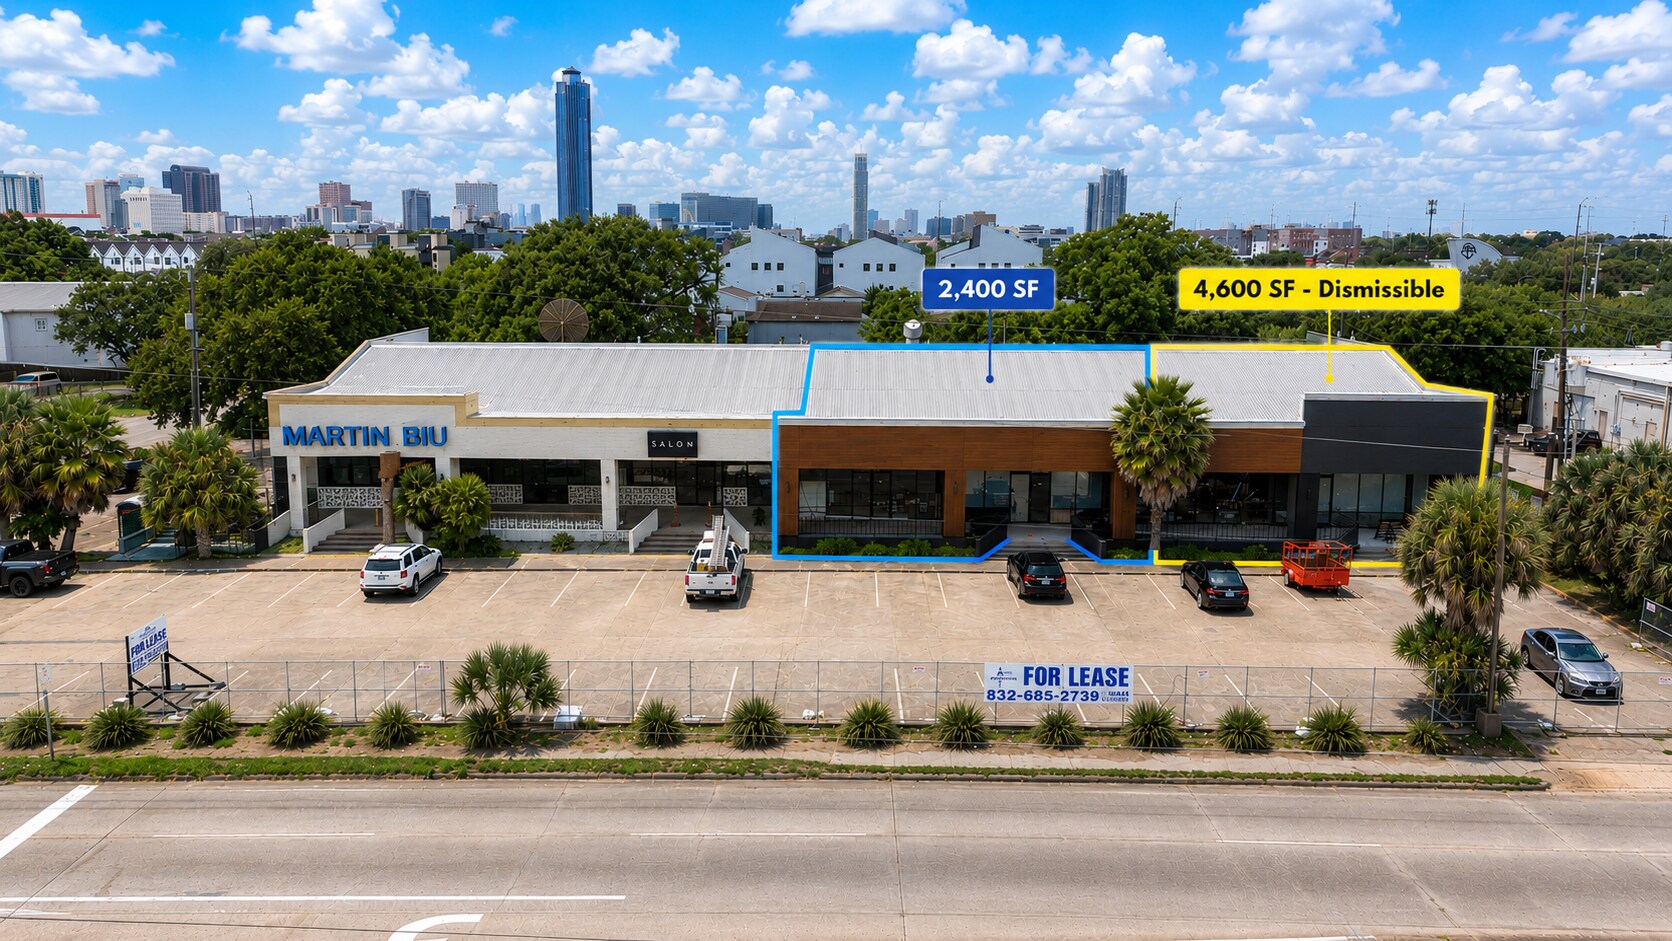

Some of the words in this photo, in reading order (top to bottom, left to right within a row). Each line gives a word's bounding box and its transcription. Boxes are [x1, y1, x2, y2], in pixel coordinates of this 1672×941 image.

[282, 425, 390, 447] MARTIN
[402, 425, 448, 447] BIU
[651, 440, 693, 448] SALON
[145, 627, 167, 649] LEASE
[1023, 666, 1061, 687] FOR
[1068, 666, 1130, 688] LEASE
[986, 689, 1100, 702] 832-685-2739
